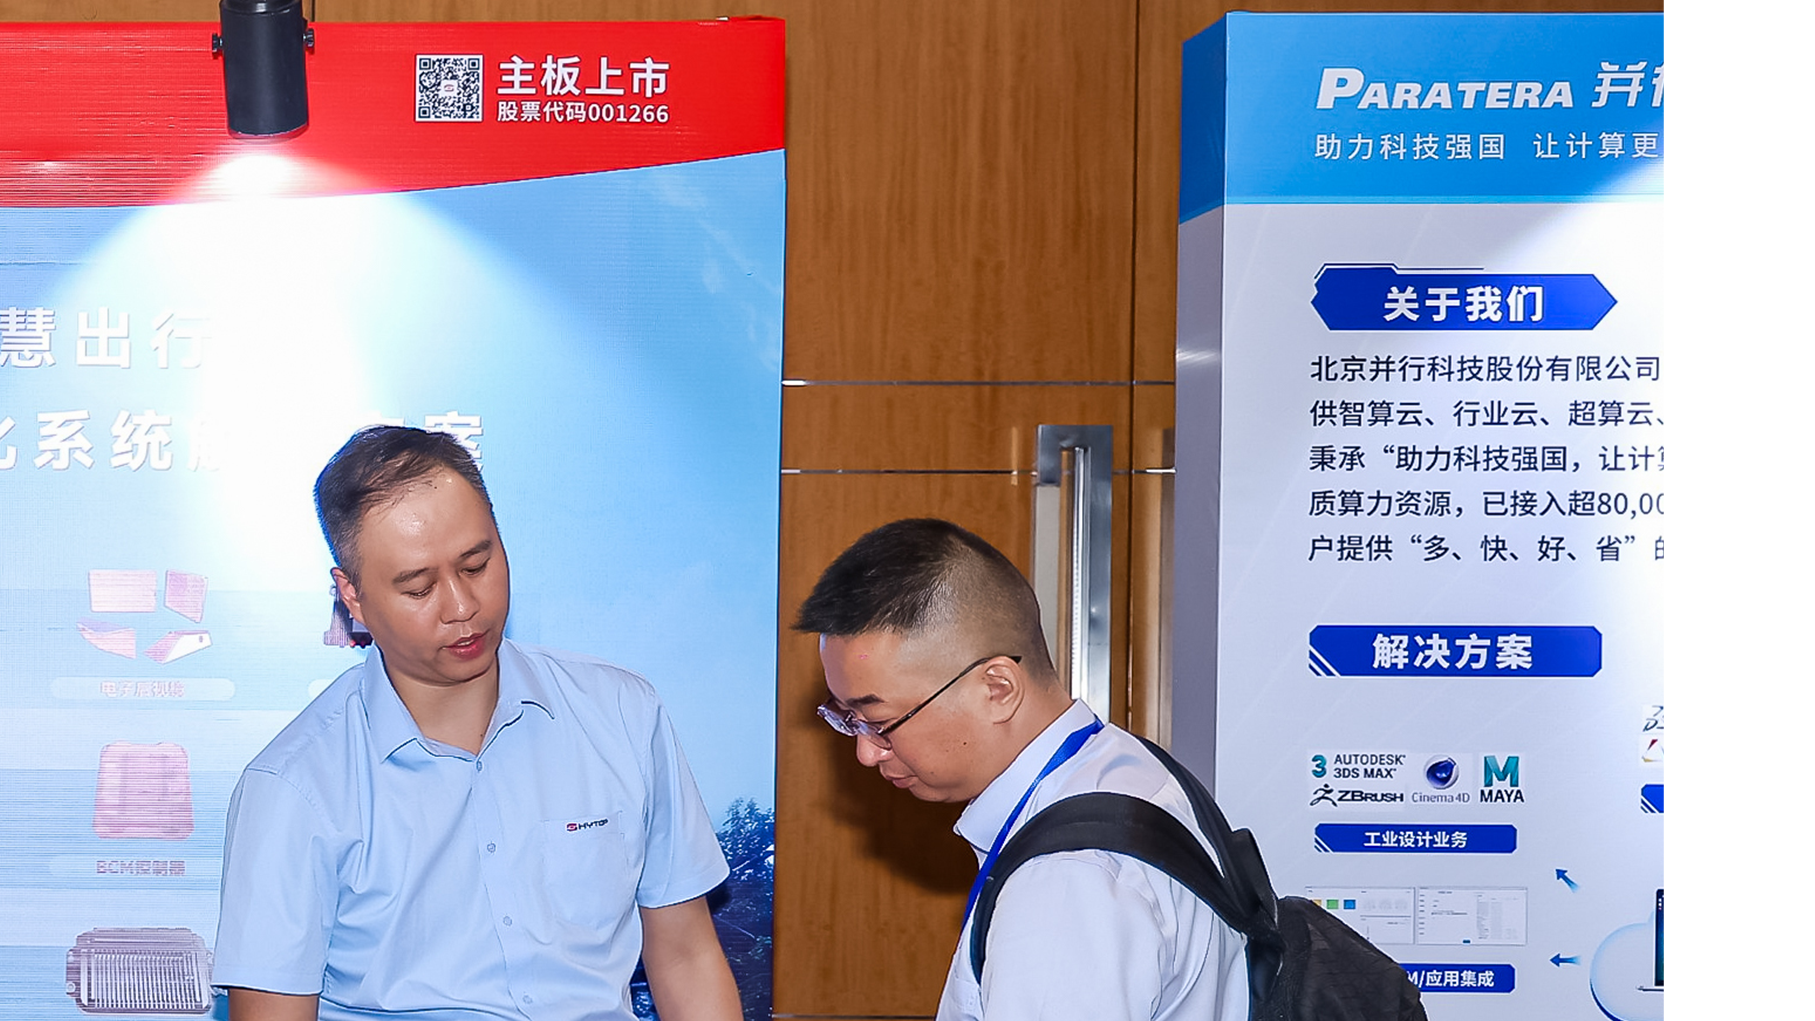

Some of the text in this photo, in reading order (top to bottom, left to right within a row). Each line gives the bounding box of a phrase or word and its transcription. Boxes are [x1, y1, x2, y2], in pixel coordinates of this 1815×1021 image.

[497, 55, 670, 98] 主板上市
[497, 101, 670, 123] 股票代码001266
[1315, 132, 1505, 160] 助力科技强国
[1383, 286, 1544, 322] 关于我们
[1311, 355, 1660, 382] 北京并行科技股份有限公司
[1310, 445, 1664, 473] 秉承“助力科技强国，让计
[1372, 634, 1533, 669] 解决方案
[1334, 754, 1404, 765] AUTODESK
[1334, 768, 1359, 778] 3DS
[1480, 790, 1525, 803] MAYA
[1364, 831, 1468, 848] 工业设计业务
